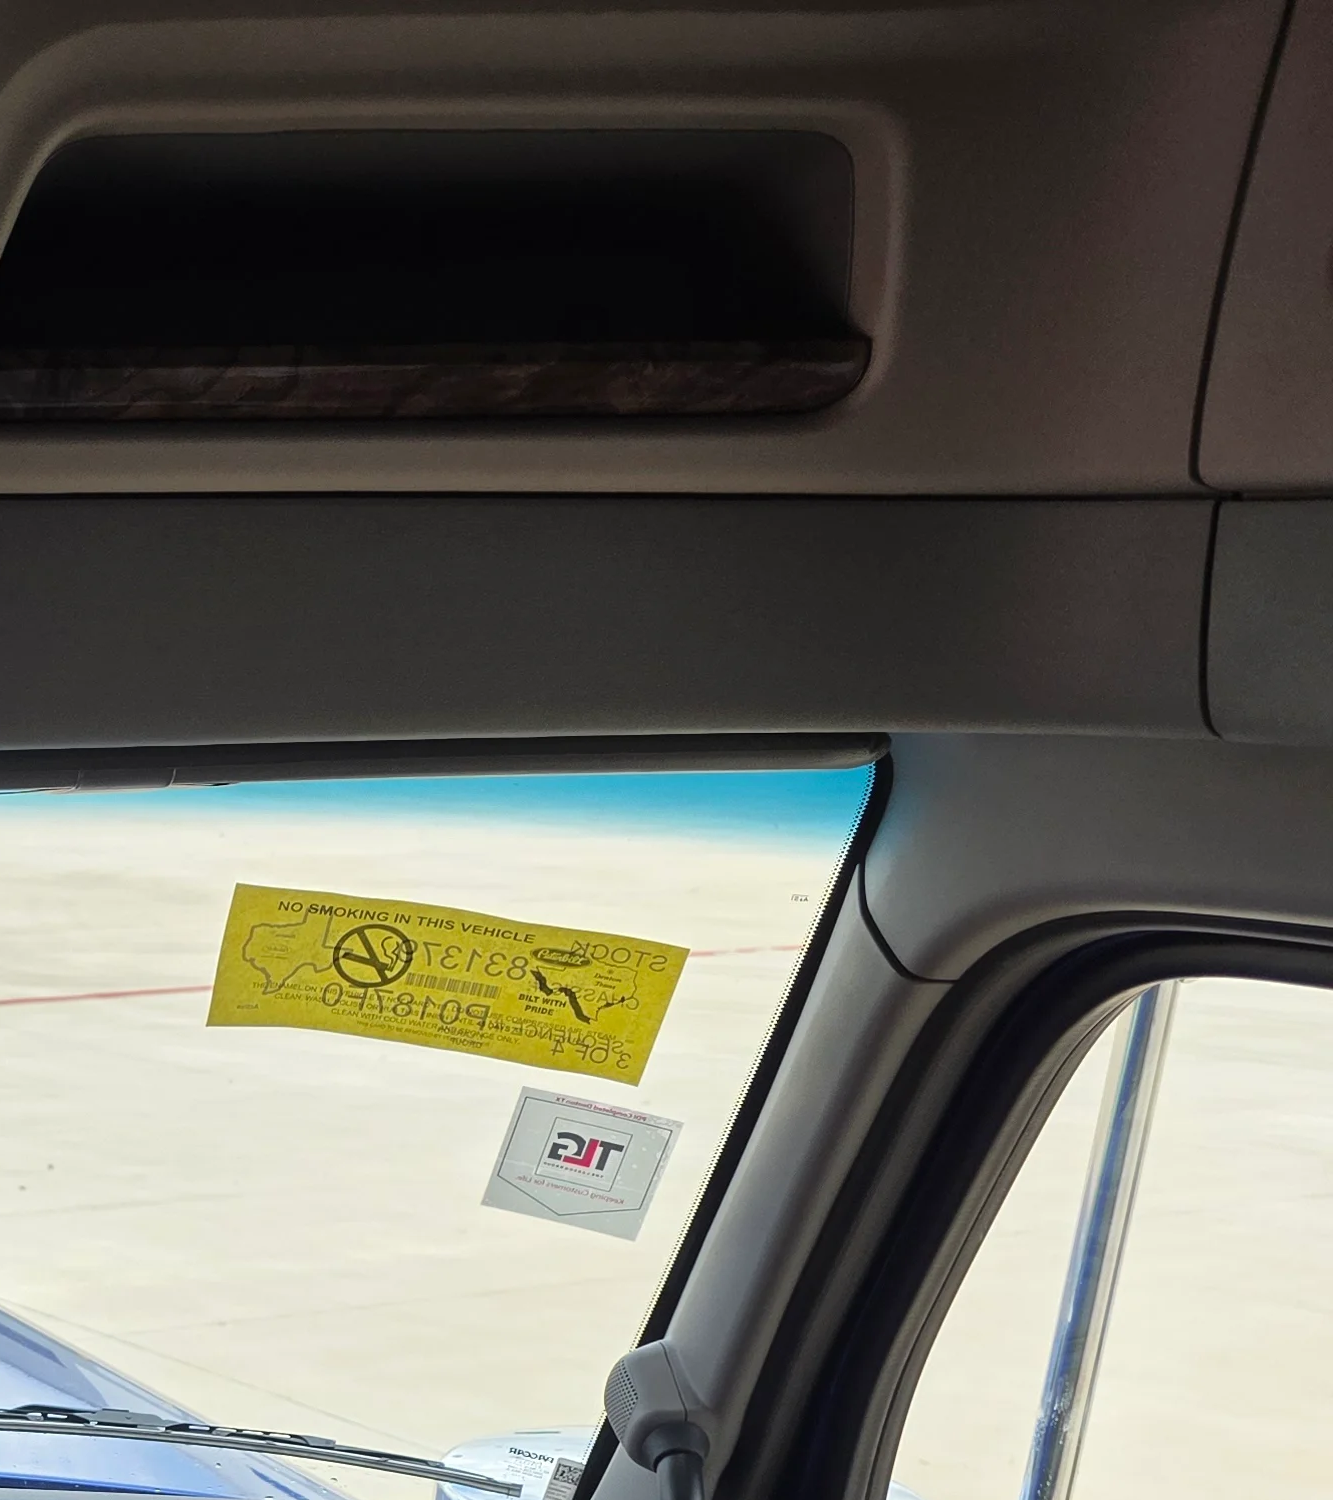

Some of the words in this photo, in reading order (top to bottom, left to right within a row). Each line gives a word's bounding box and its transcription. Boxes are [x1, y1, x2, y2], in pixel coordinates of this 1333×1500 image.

[278, 901, 303, 913] NO
[308, 903, 389, 922] SMOKING
[394, 912, 412, 924] IN
[417, 915, 455, 930] THIS
[461, 923, 536, 944] VEHICLE
[518, 993, 539, 1004] BILT
[542, 998, 567, 1009] WITH
[524, 1004, 555, 1017] PRIDE
